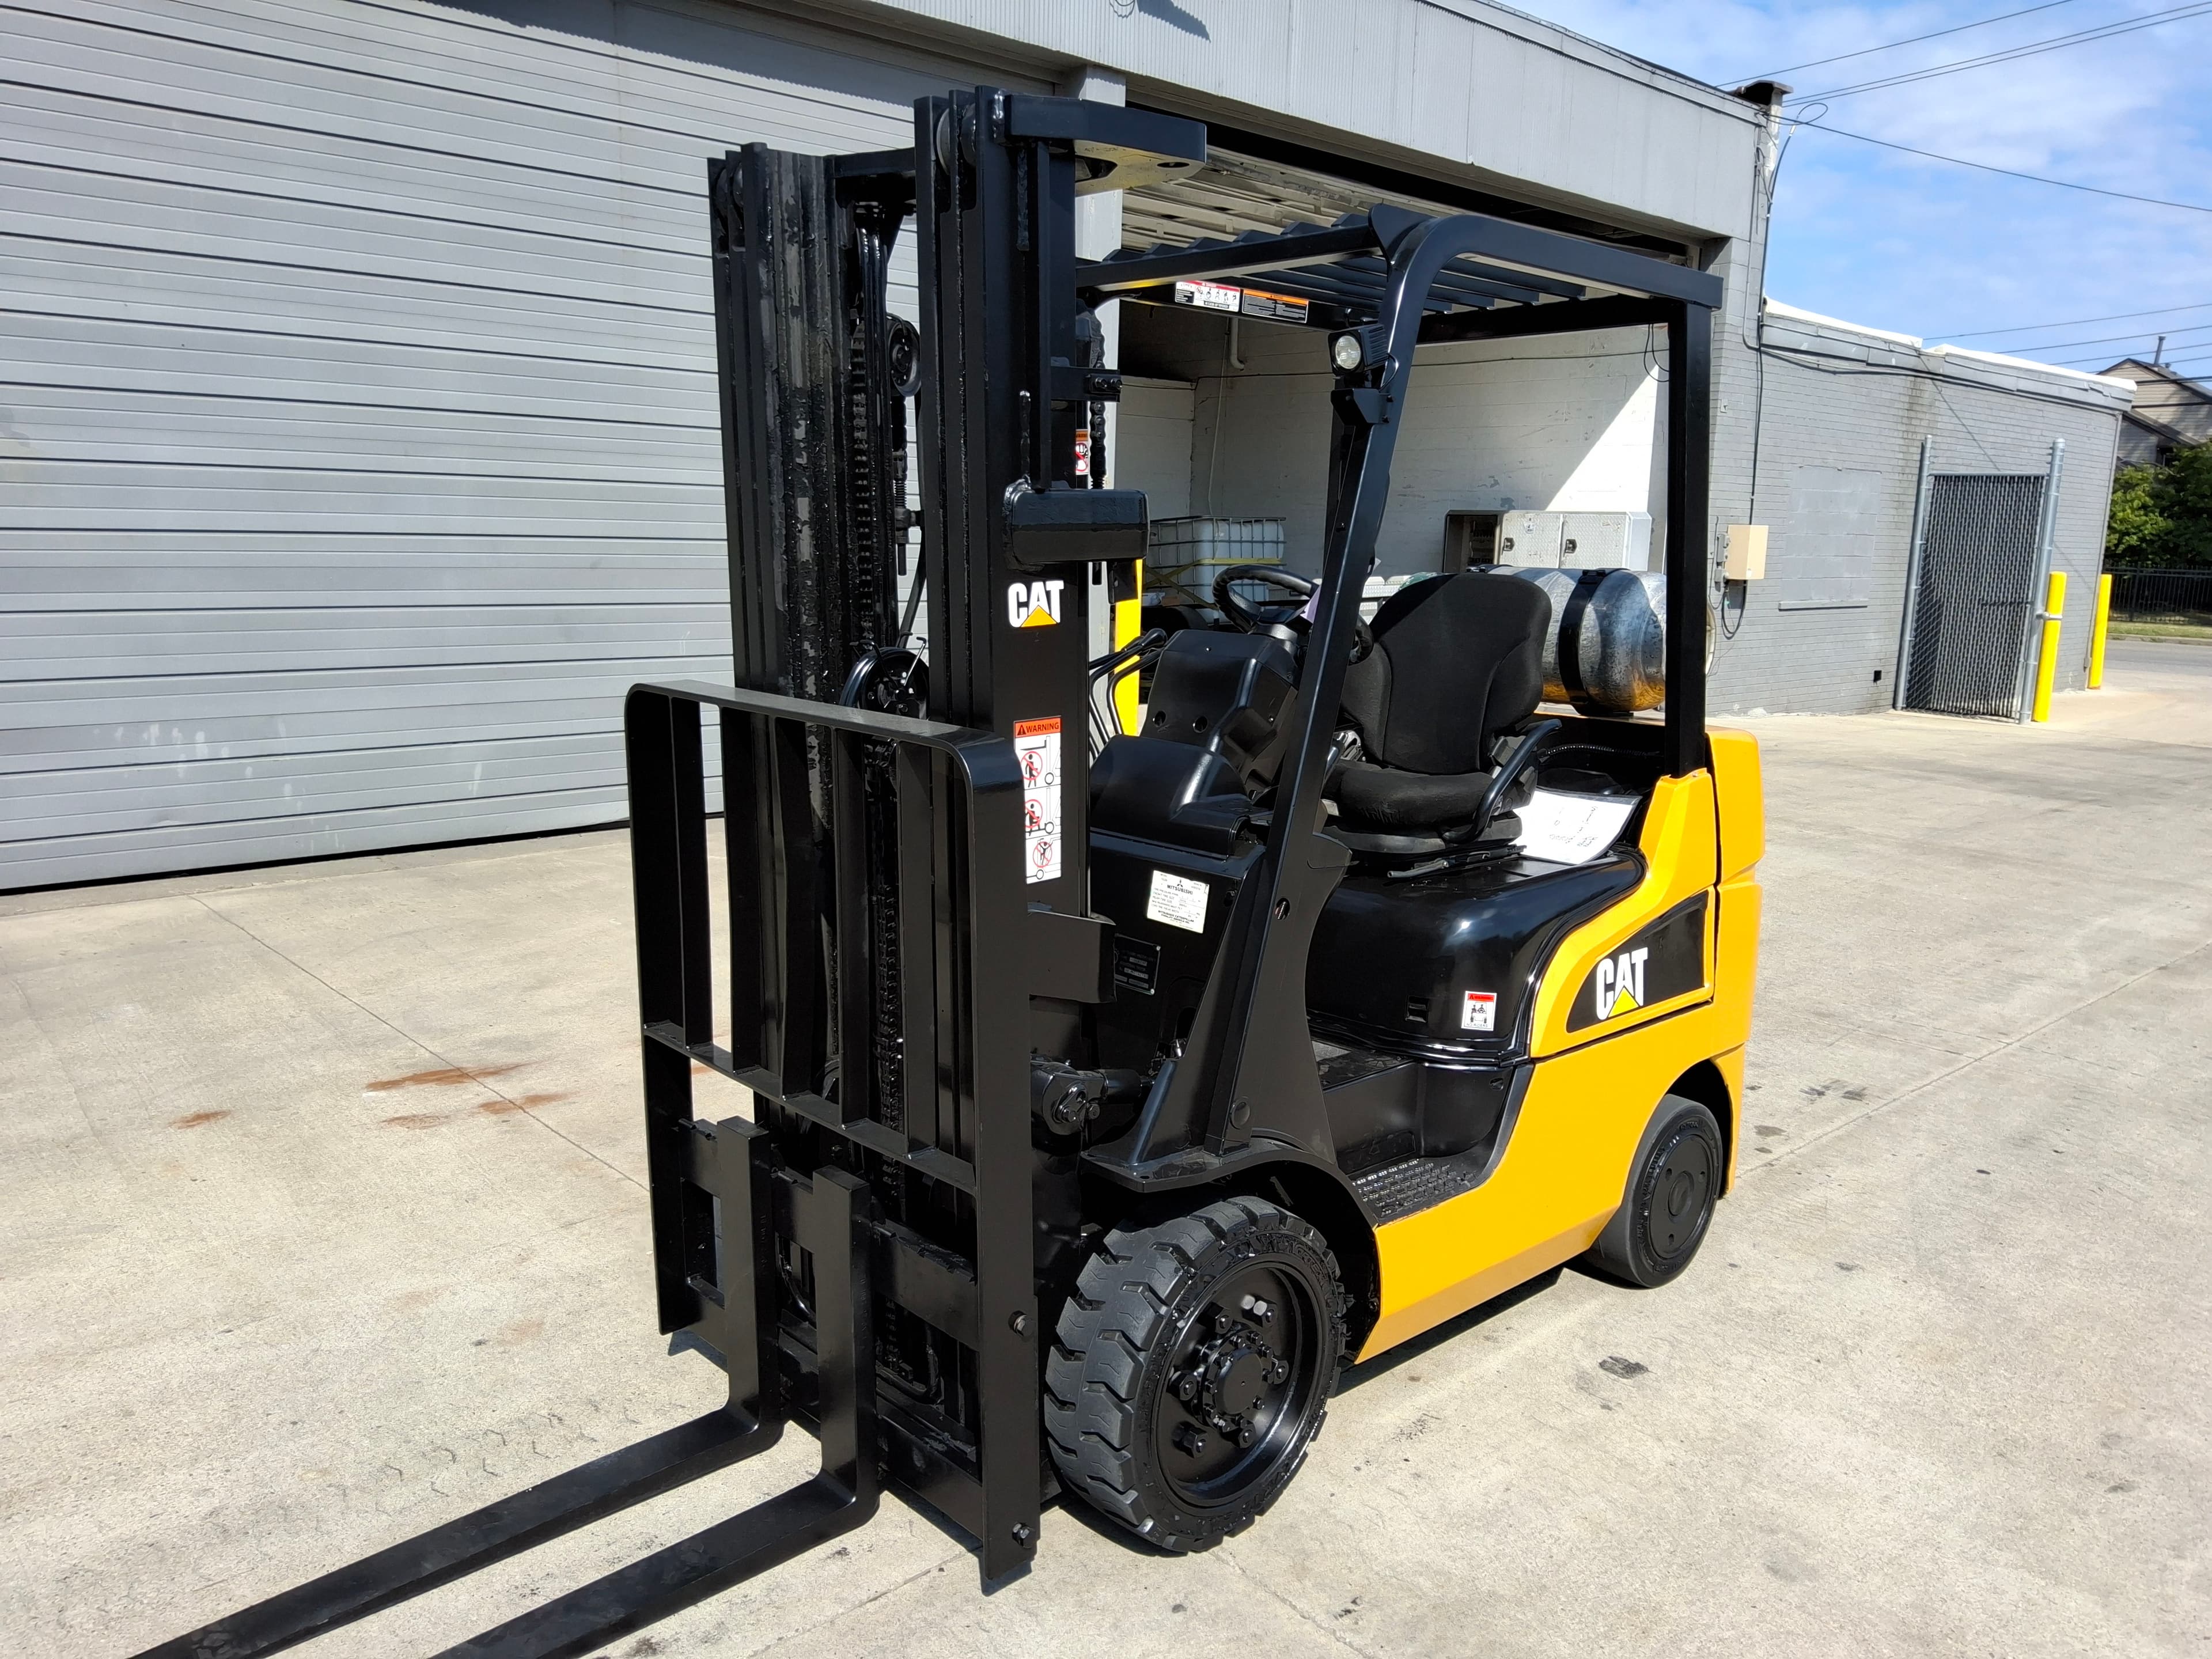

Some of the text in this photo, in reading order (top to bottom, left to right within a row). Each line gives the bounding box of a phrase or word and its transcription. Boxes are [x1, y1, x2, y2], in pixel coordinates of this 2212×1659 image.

[1008, 581, 1064, 628] CAT
[1026, 722, 1059, 733] WARNING
[1167, 884, 1193, 895] MITSUBISHI
[1597, 947, 1648, 1020] CAT
